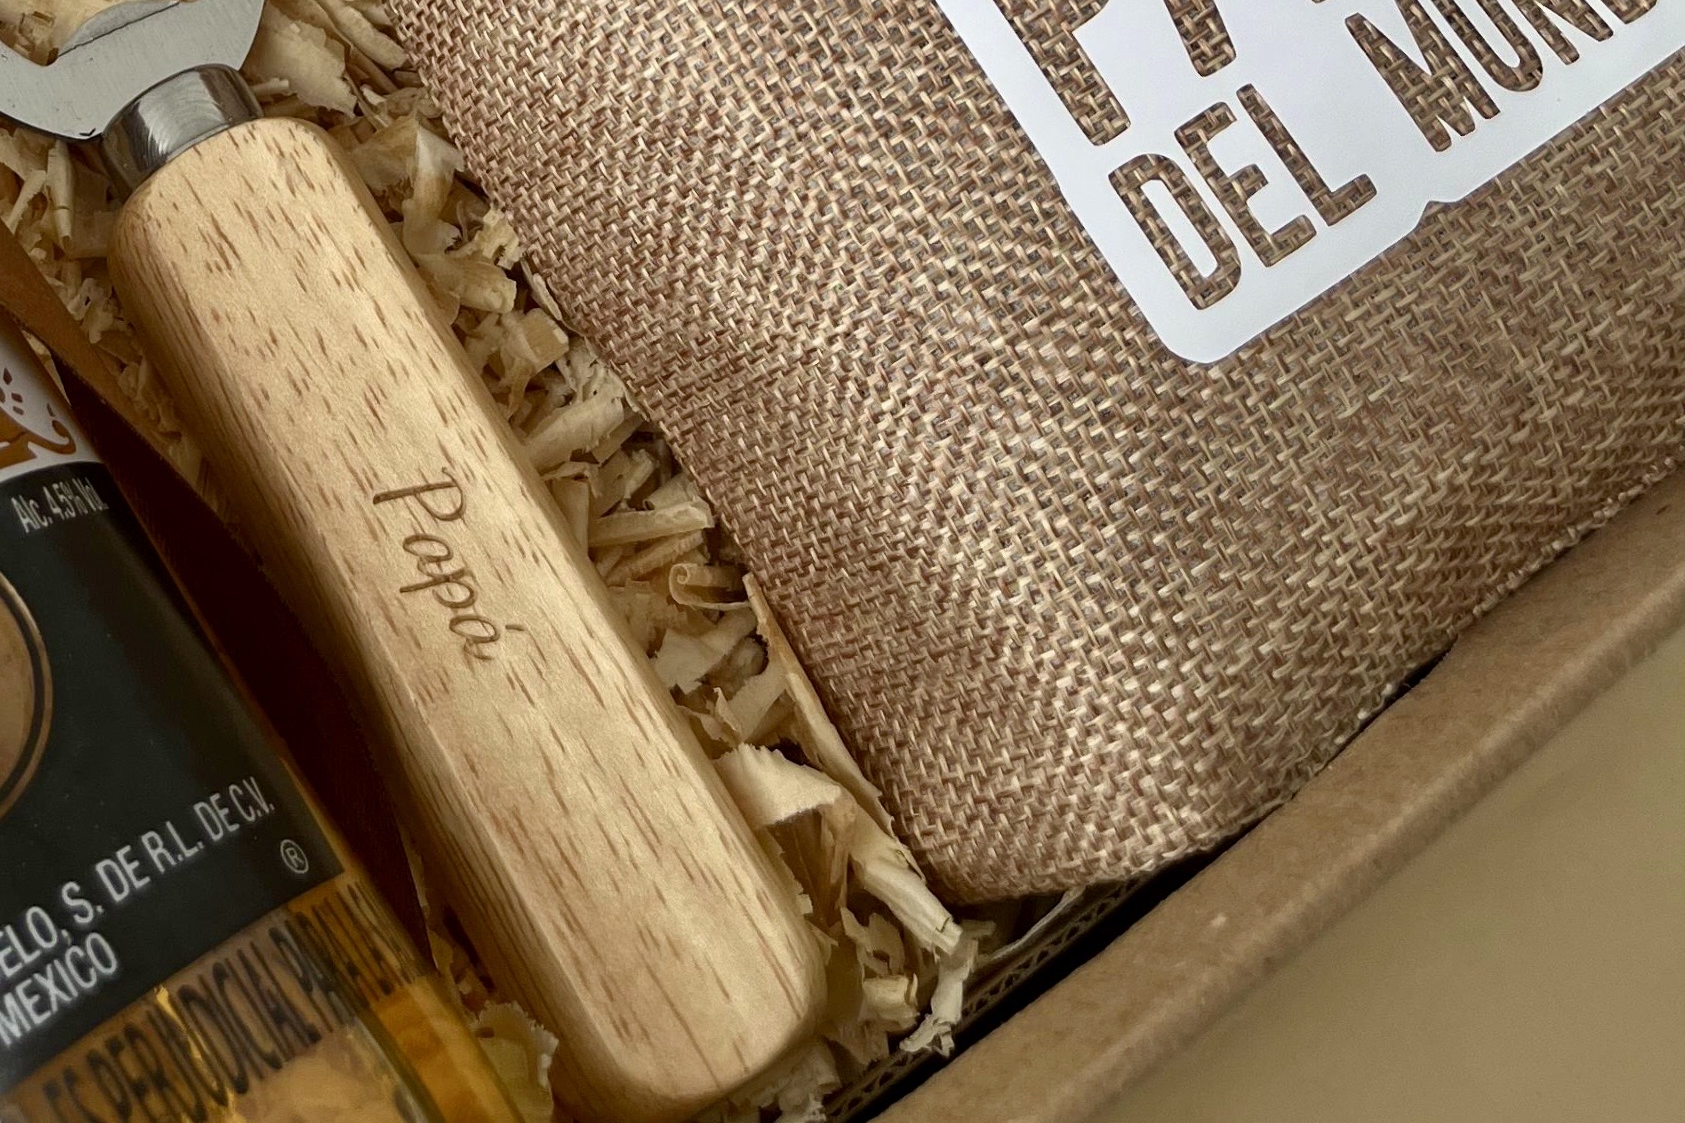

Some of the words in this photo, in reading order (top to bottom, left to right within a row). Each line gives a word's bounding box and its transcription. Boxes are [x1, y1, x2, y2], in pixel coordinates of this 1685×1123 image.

[1107, 83, 1378, 312] DEL
[11, 494, 54, 534] Alc.
[373, 467, 526, 661] Papá
[60, 880, 105, 924] S.
[94, 844, 151, 903] DE
[140, 820, 205, 874] R.L.
[192, 792, 240, 843] DE
[228, 776, 276, 823] C.V.
[0, 931, 118, 1047] MEXICO
